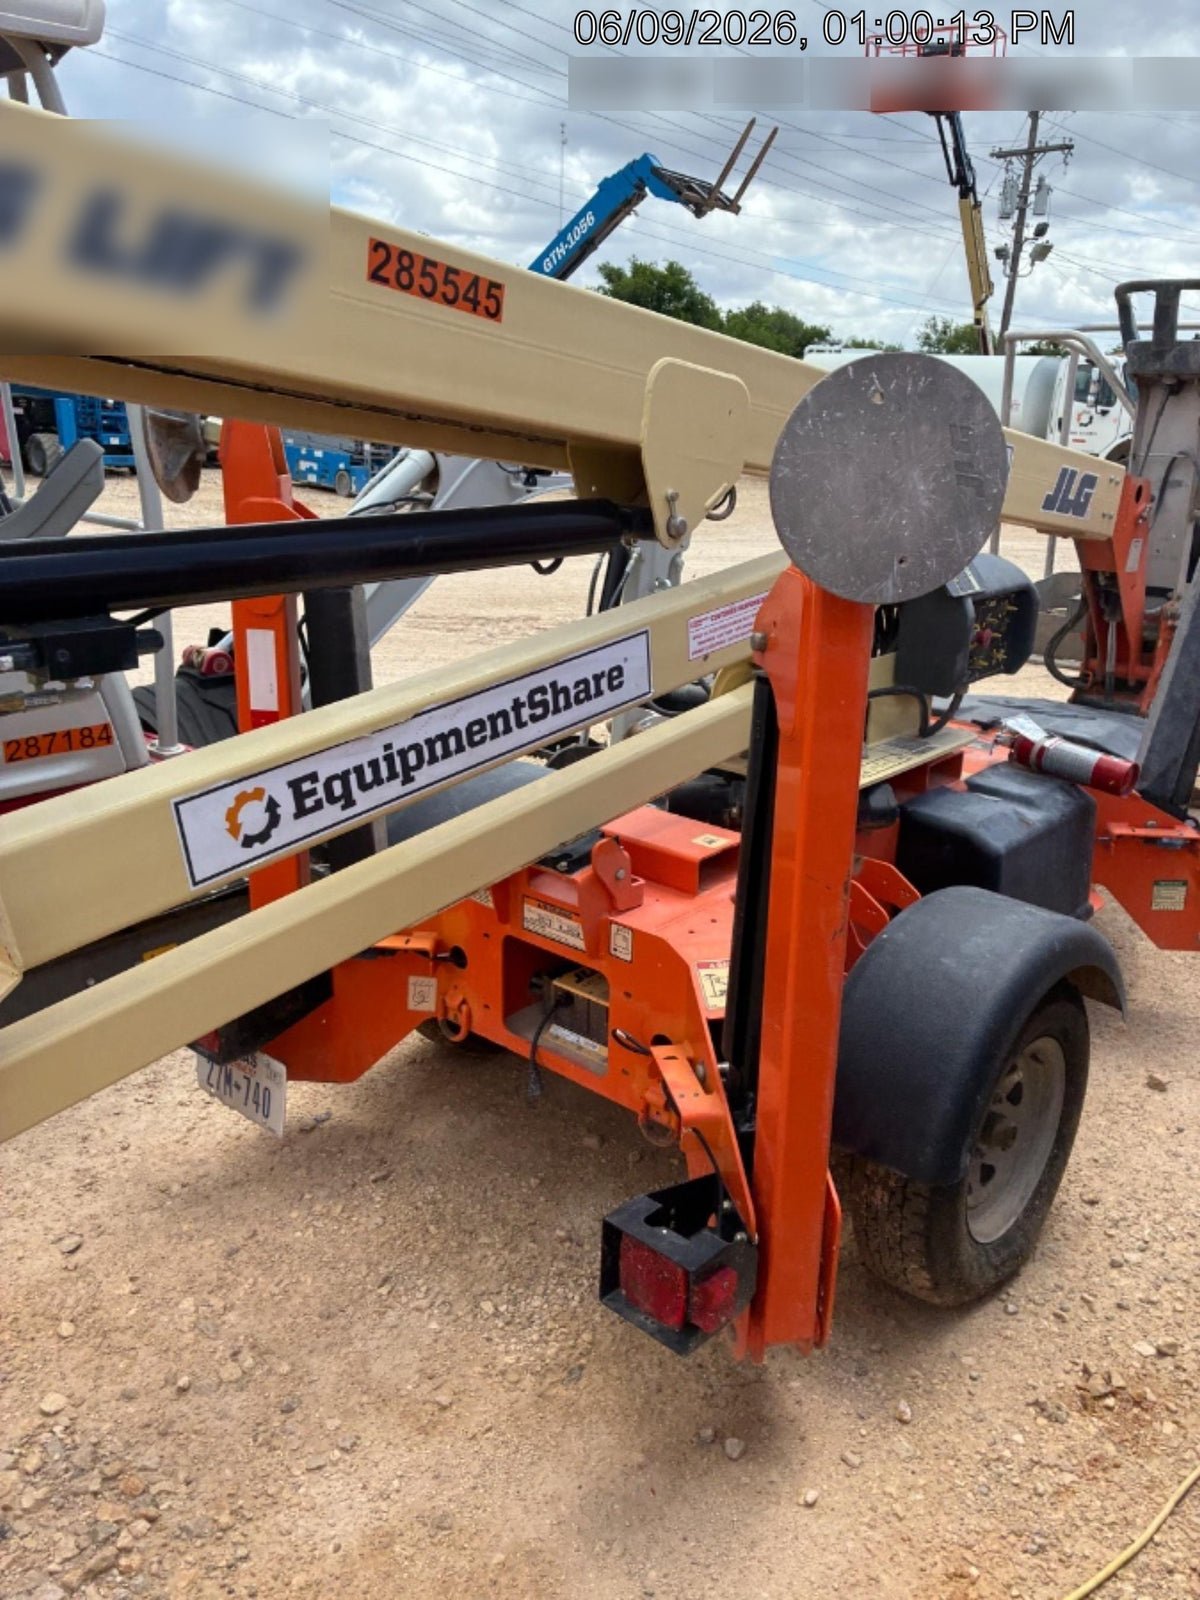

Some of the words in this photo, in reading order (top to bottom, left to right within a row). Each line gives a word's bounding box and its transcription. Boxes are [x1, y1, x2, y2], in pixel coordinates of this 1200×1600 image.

[543, 211, 595, 272] GTH-1056
[371, 241, 501, 318] 285545
[1041, 467, 1098, 517] JLG
[6, 723, 113, 762] 287184
[288, 663, 626, 820] EquipmentShare
